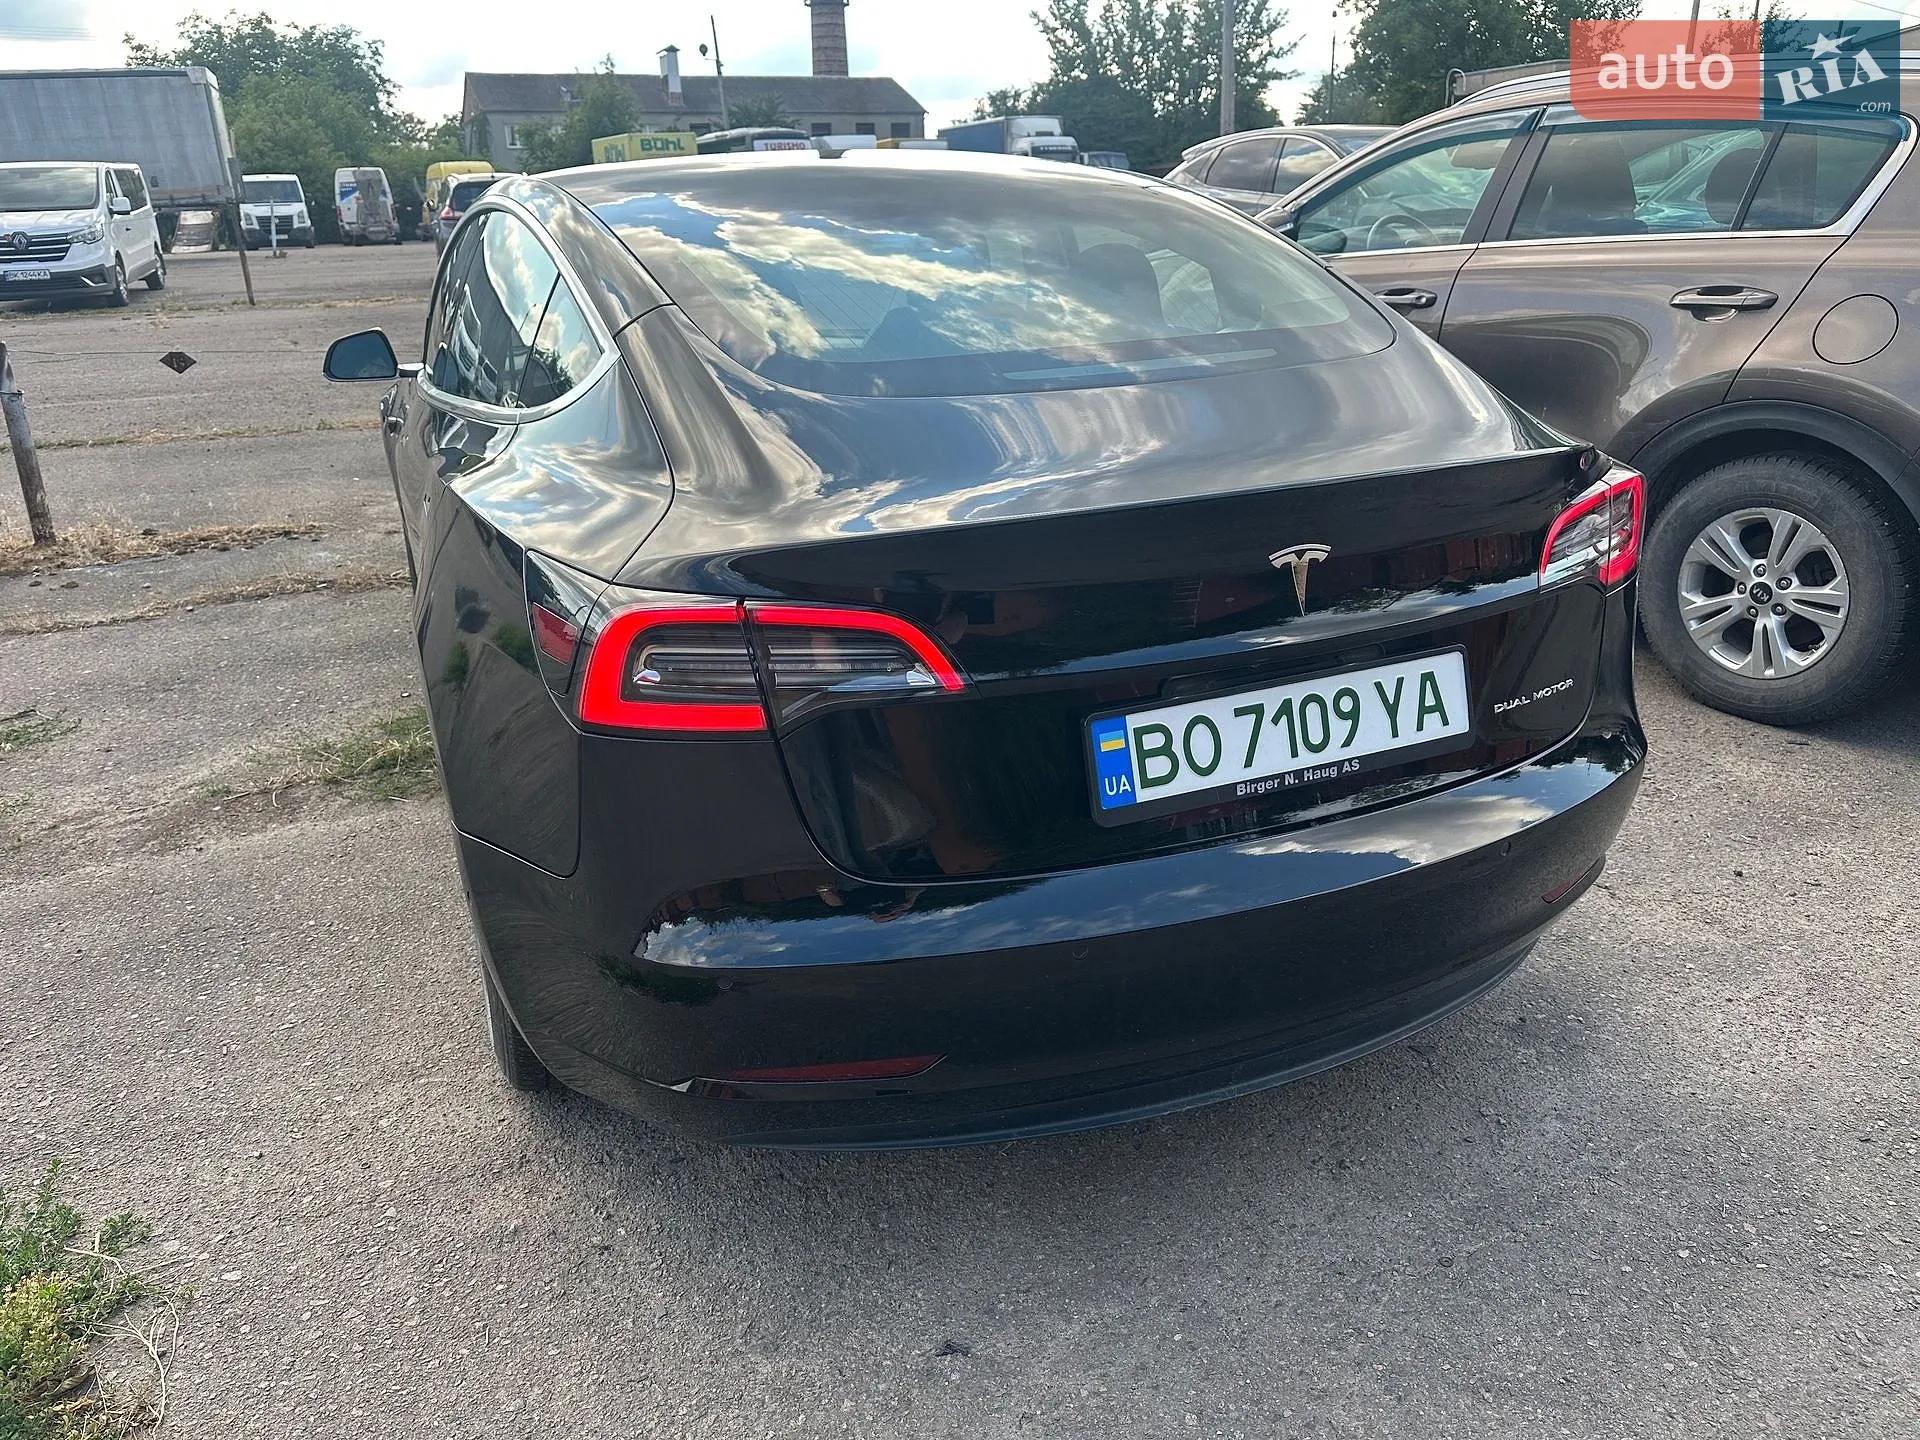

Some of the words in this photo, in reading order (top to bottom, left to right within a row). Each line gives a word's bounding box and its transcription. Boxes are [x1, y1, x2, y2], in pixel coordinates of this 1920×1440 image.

[1752, 585, 1770, 602] KIA
[1493, 696, 1531, 713] DUAL
[1532, 679, 1574, 701] MOTOR
[1133, 714, 1222, 789] BO
[1233, 687, 1361, 768] 7109
[1373, 671, 1449, 739] YA
[1104, 775, 1131, 796] UA
[1236, 778, 1280, 796] Birger
[1284, 773, 1299, 786] N.
[1303, 765, 1338, 781] Haug
[1342, 759, 1360, 773] AS
